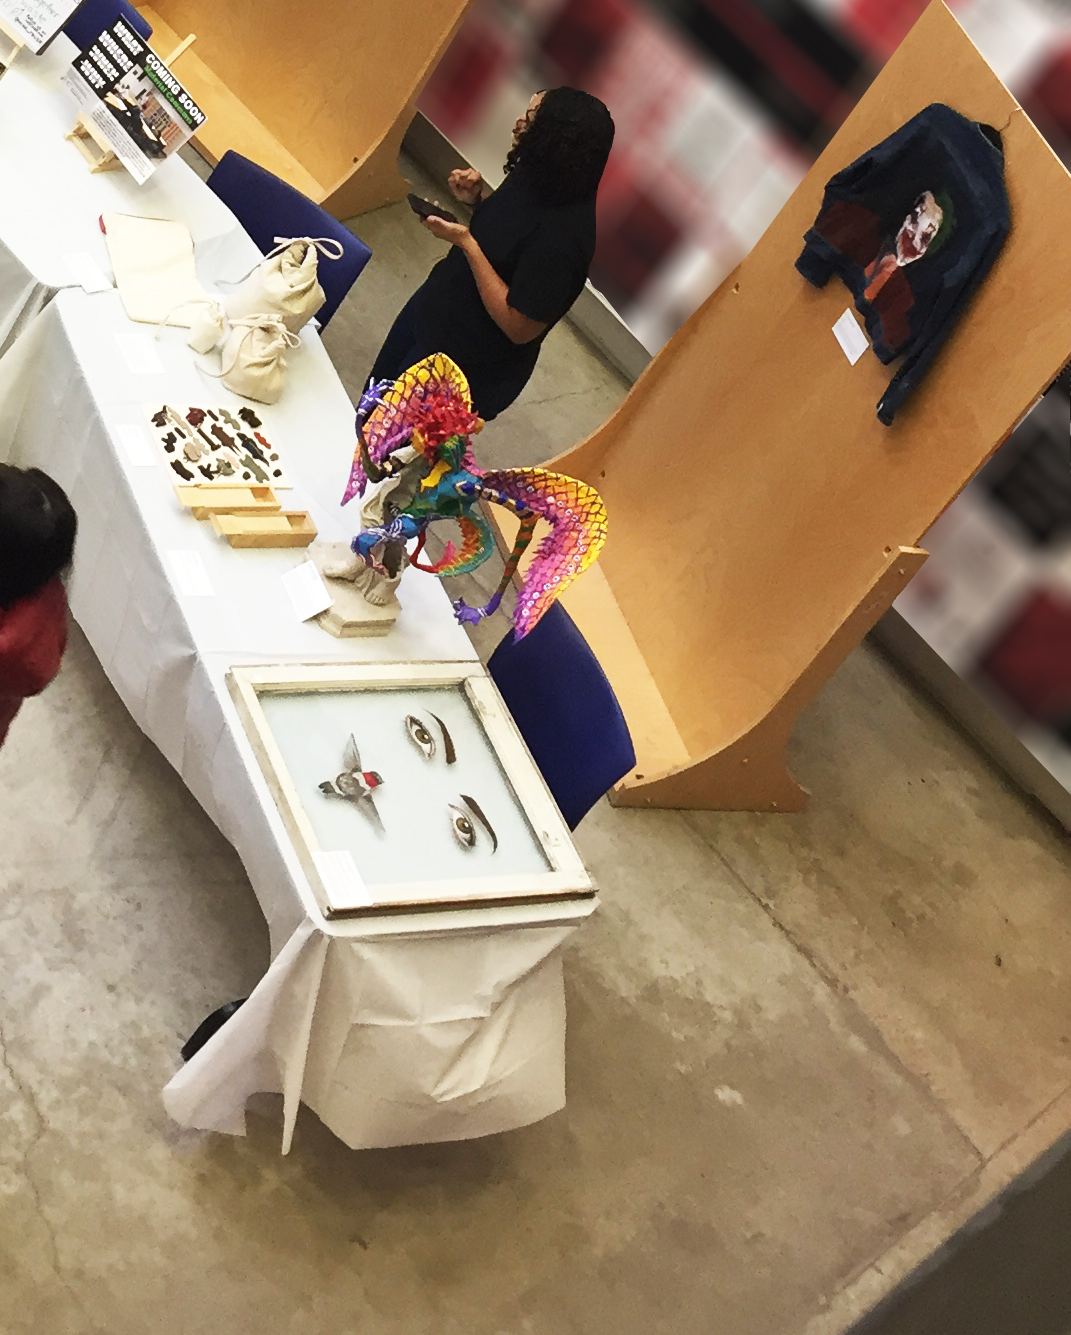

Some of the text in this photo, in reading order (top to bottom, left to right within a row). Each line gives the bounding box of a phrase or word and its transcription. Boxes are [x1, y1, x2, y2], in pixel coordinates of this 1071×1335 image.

[113, 20, 144, 56] WHAT
[143, 66, 168, 94] Material
[145, 53, 206, 125] COMING SOON
